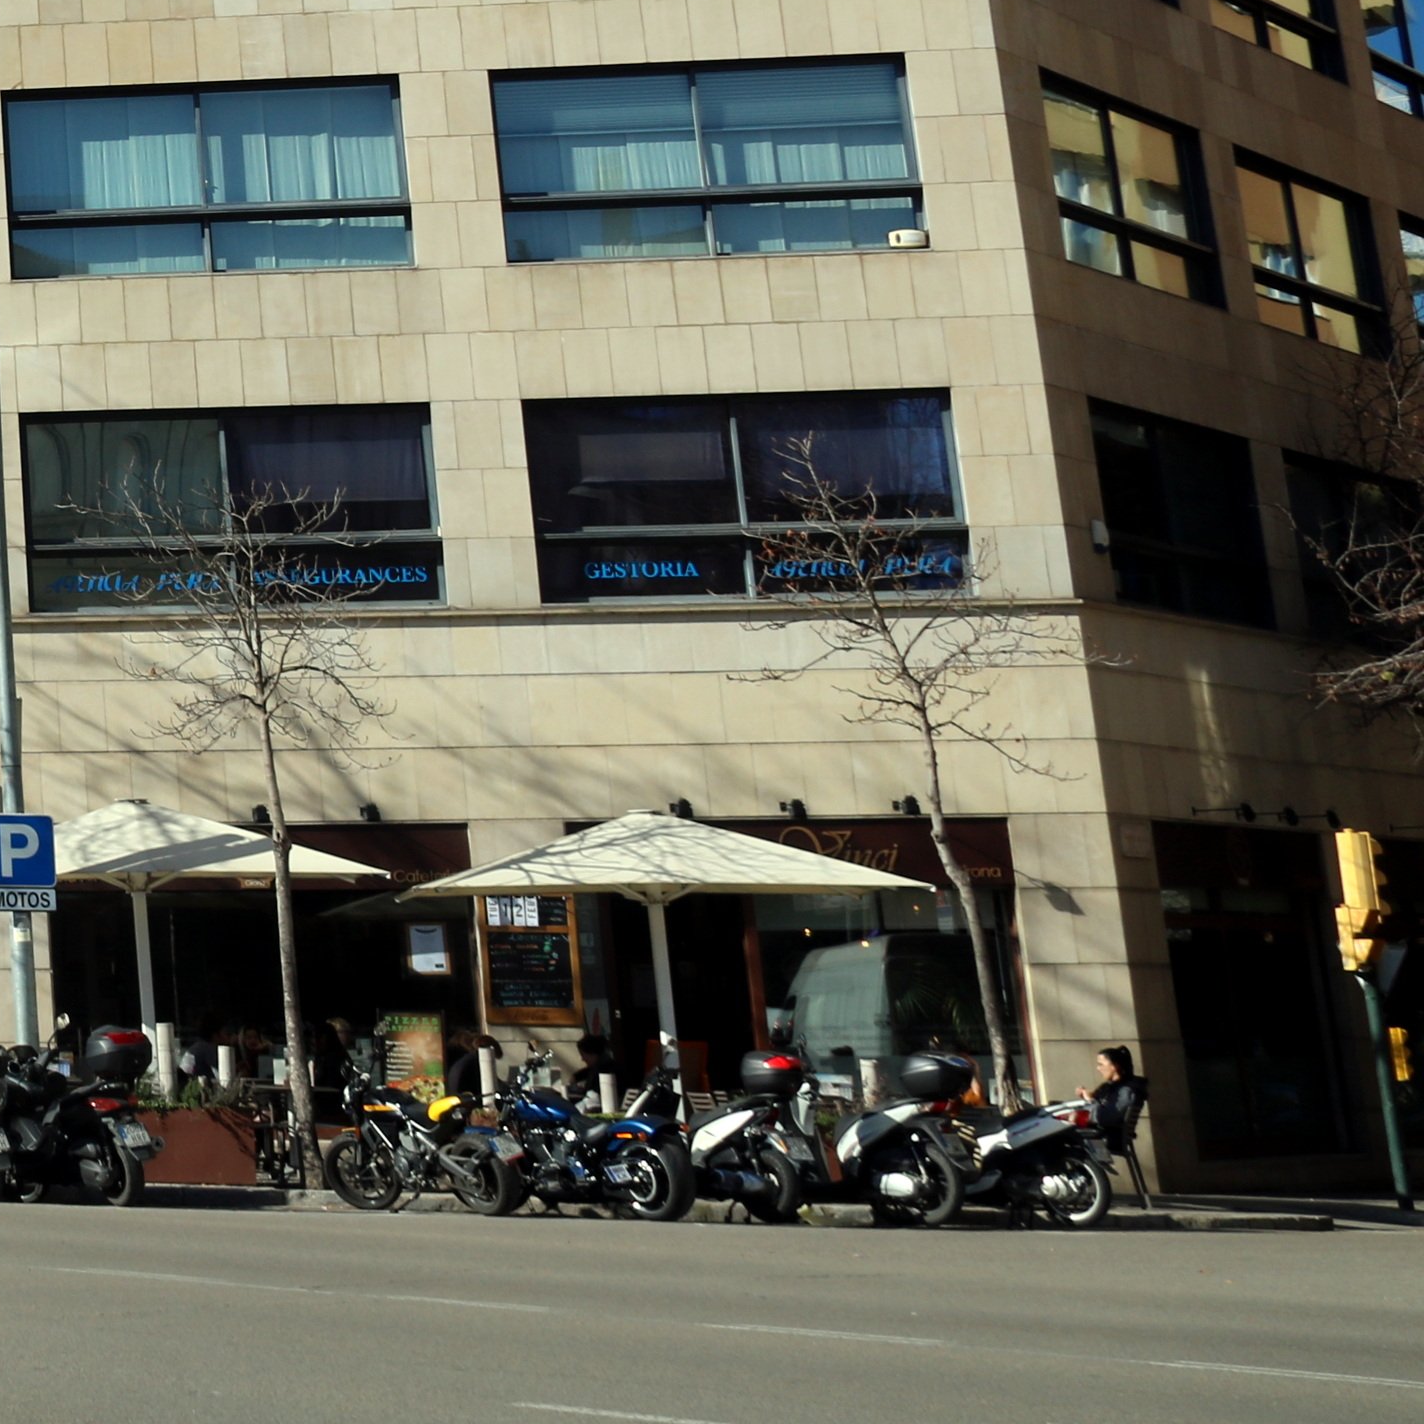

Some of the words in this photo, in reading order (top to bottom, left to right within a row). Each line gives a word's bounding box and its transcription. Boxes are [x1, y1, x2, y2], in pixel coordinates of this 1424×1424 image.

[253, 566, 428, 586] ASSEGURANCES
[584, 561, 700, 579] GESTORIA
[0, 823, 40, 878] P
